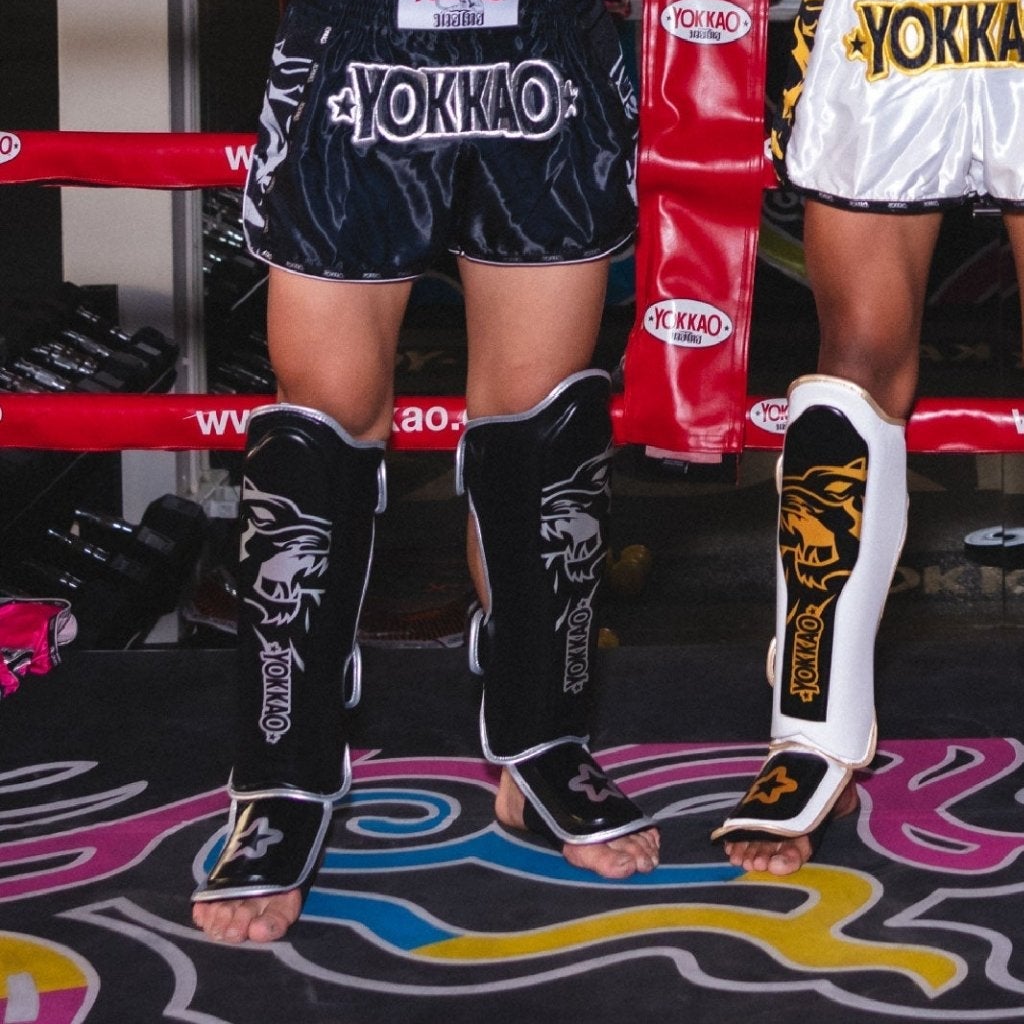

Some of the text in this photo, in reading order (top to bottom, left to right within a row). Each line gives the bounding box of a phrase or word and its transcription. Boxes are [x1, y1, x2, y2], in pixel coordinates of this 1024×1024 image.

[673, 6, 740, 33] YOKKAO
[350, 61, 560, 141] YOKKAO
[655, 307, 722, 336] YOKKAO
[564, 607, 592, 692] YOKKAO
[790, 614, 824, 694] YOKKAO
[260, 648, 291, 733] YOKKAO
